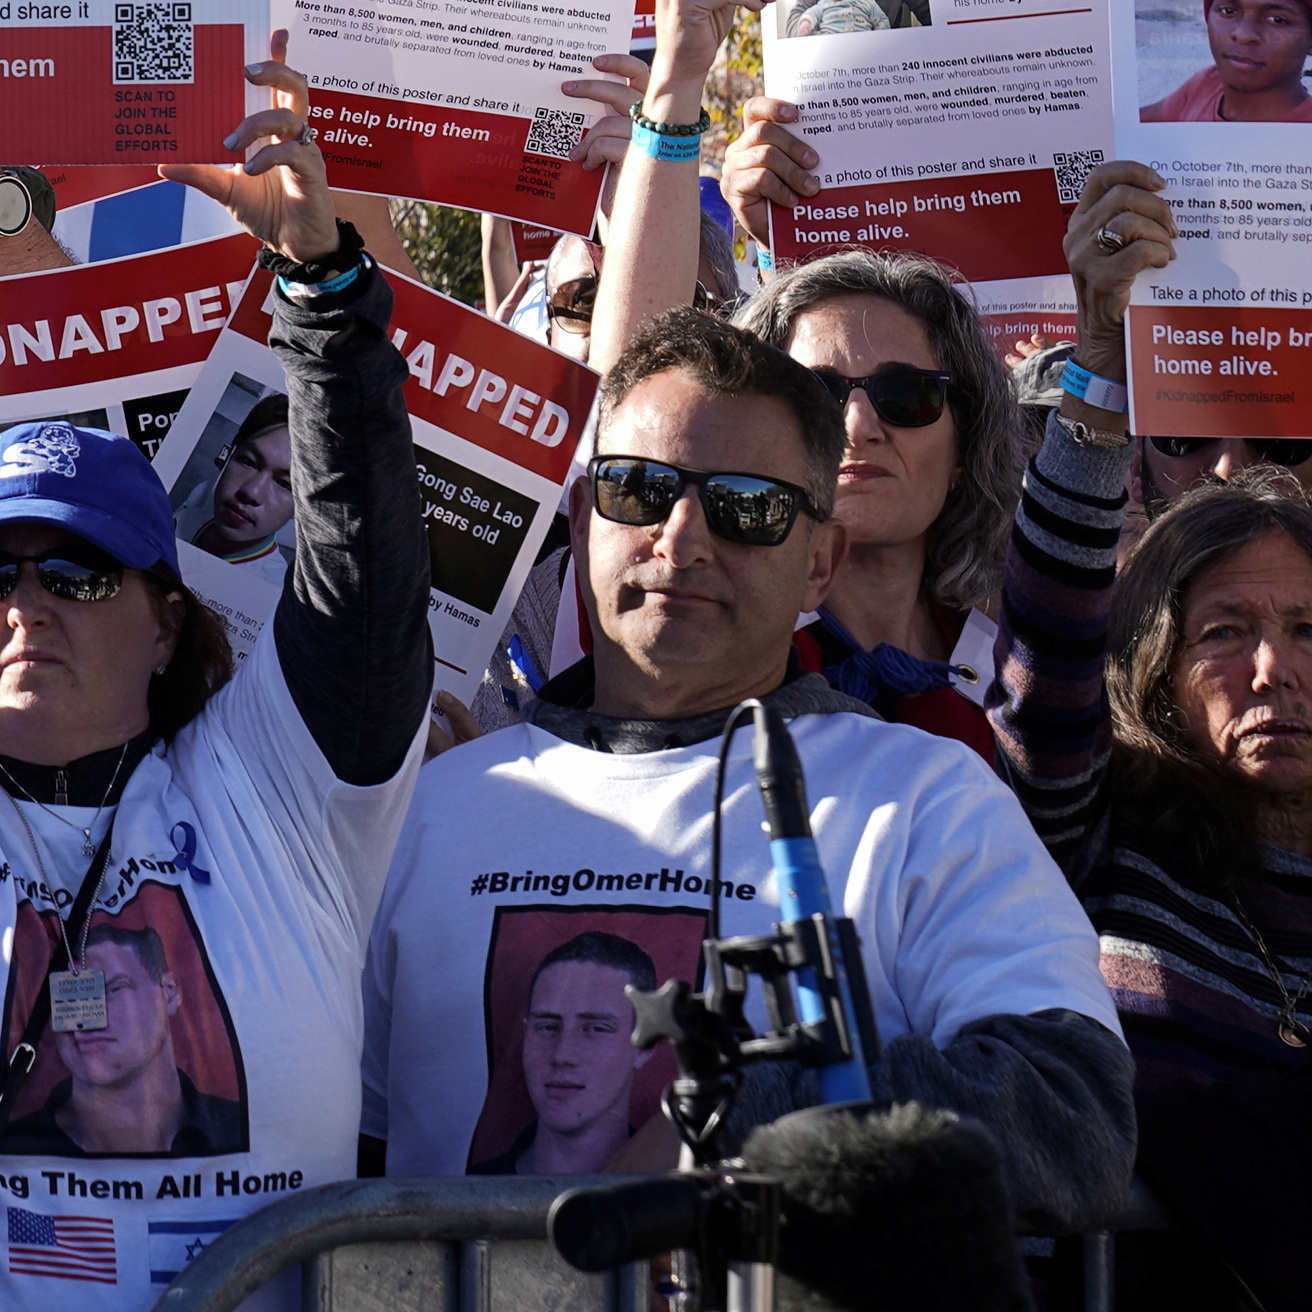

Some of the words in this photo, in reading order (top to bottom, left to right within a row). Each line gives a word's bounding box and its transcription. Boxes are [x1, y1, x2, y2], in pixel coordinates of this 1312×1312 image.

[1152, 324, 1224, 346] Please
[1231, 326, 1282, 351] help
[1153, 354, 1213, 375] home
[1219, 355, 1278, 376] alive.
[422, 500, 470, 532] years
[472, 524, 500, 546] old
[459, 486, 490, 514] Sae
[492, 501, 523, 529] Lao
[470, 868, 756, 900] #BringOmerHome
[41, 1171, 144, 1201] Them
[155, 1173, 202, 1200] All
[215, 1170, 303, 1197] Home
